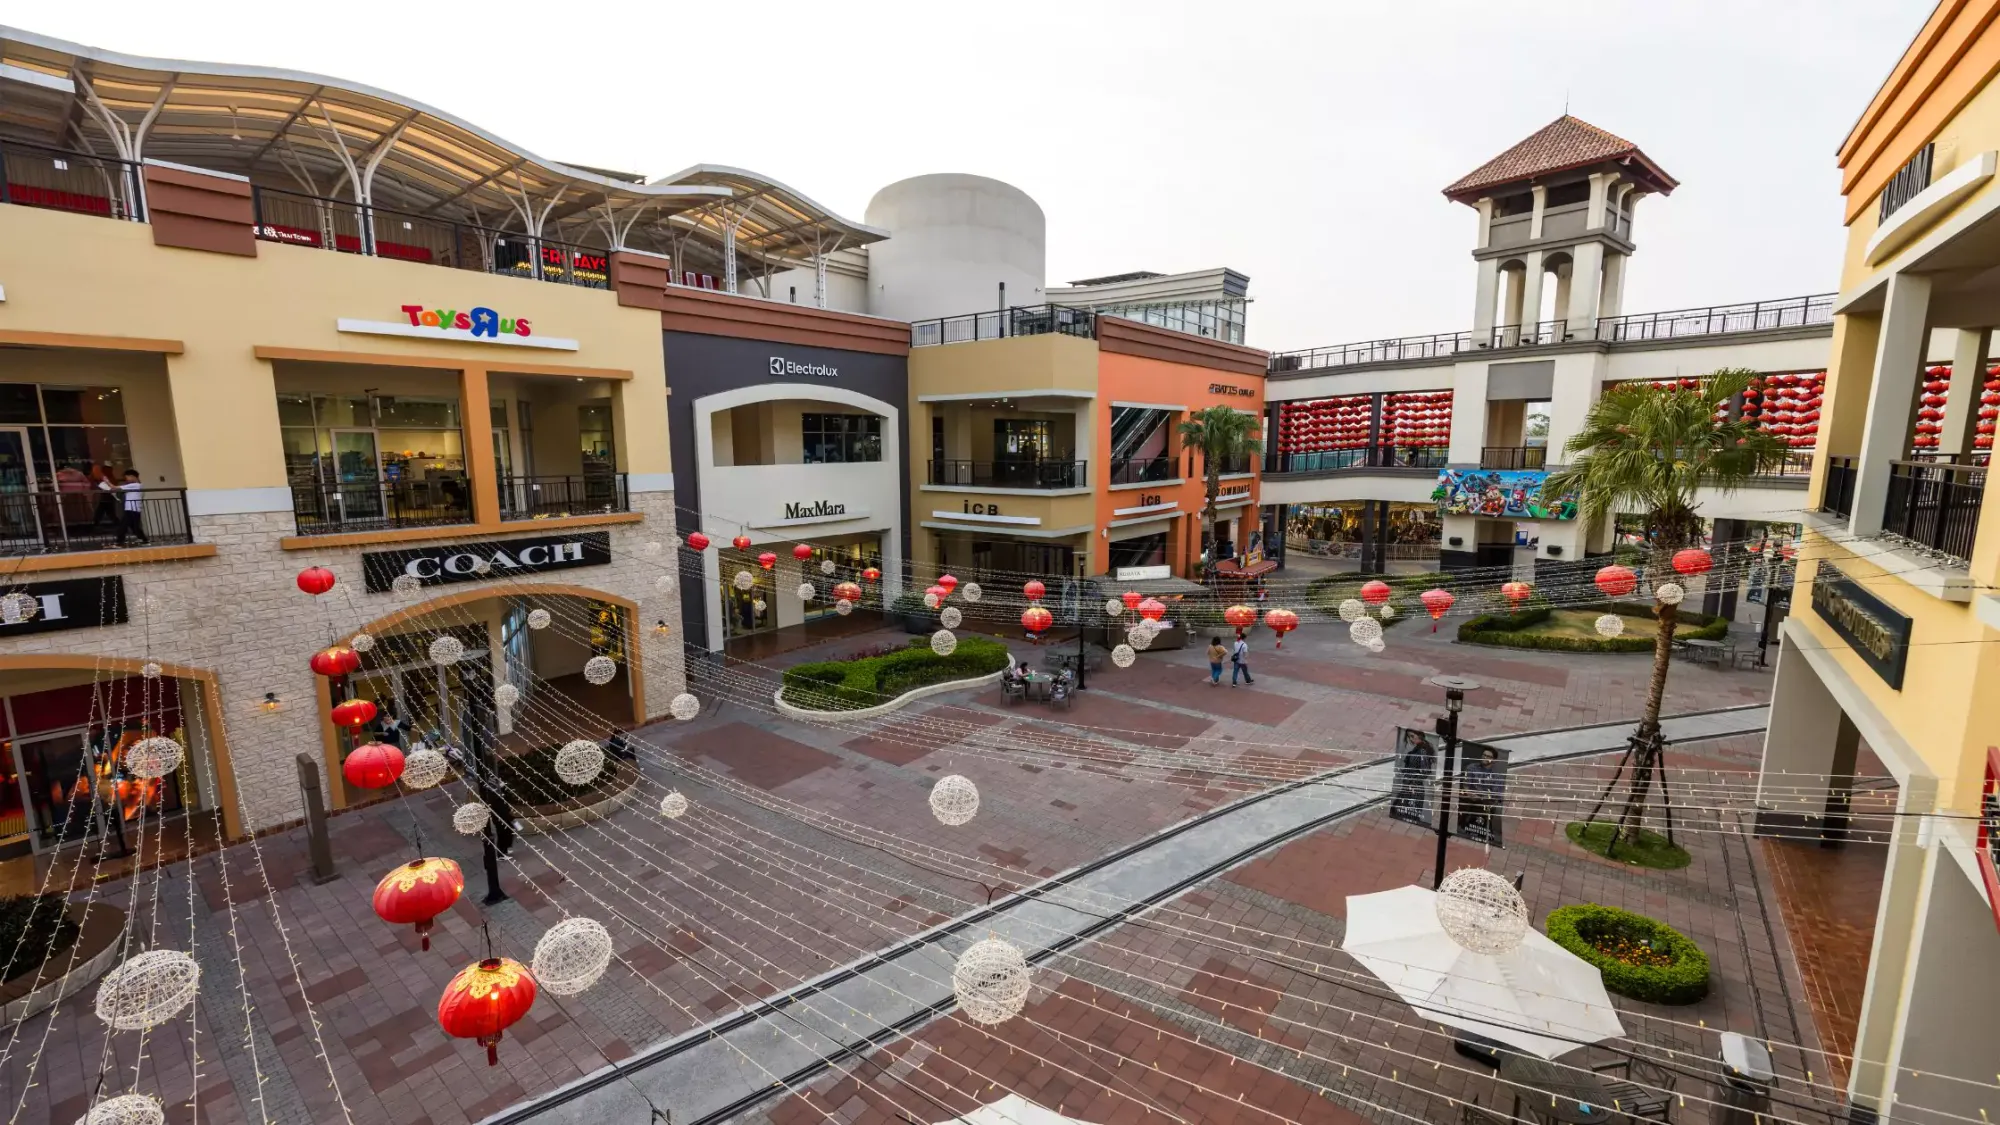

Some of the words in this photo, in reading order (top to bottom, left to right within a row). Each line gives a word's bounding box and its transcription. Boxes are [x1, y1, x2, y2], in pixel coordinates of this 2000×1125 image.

[786, 361, 838, 376] Electrolux
[784, 500, 845, 519] MaxMara
[406, 542, 584, 579] COACH
